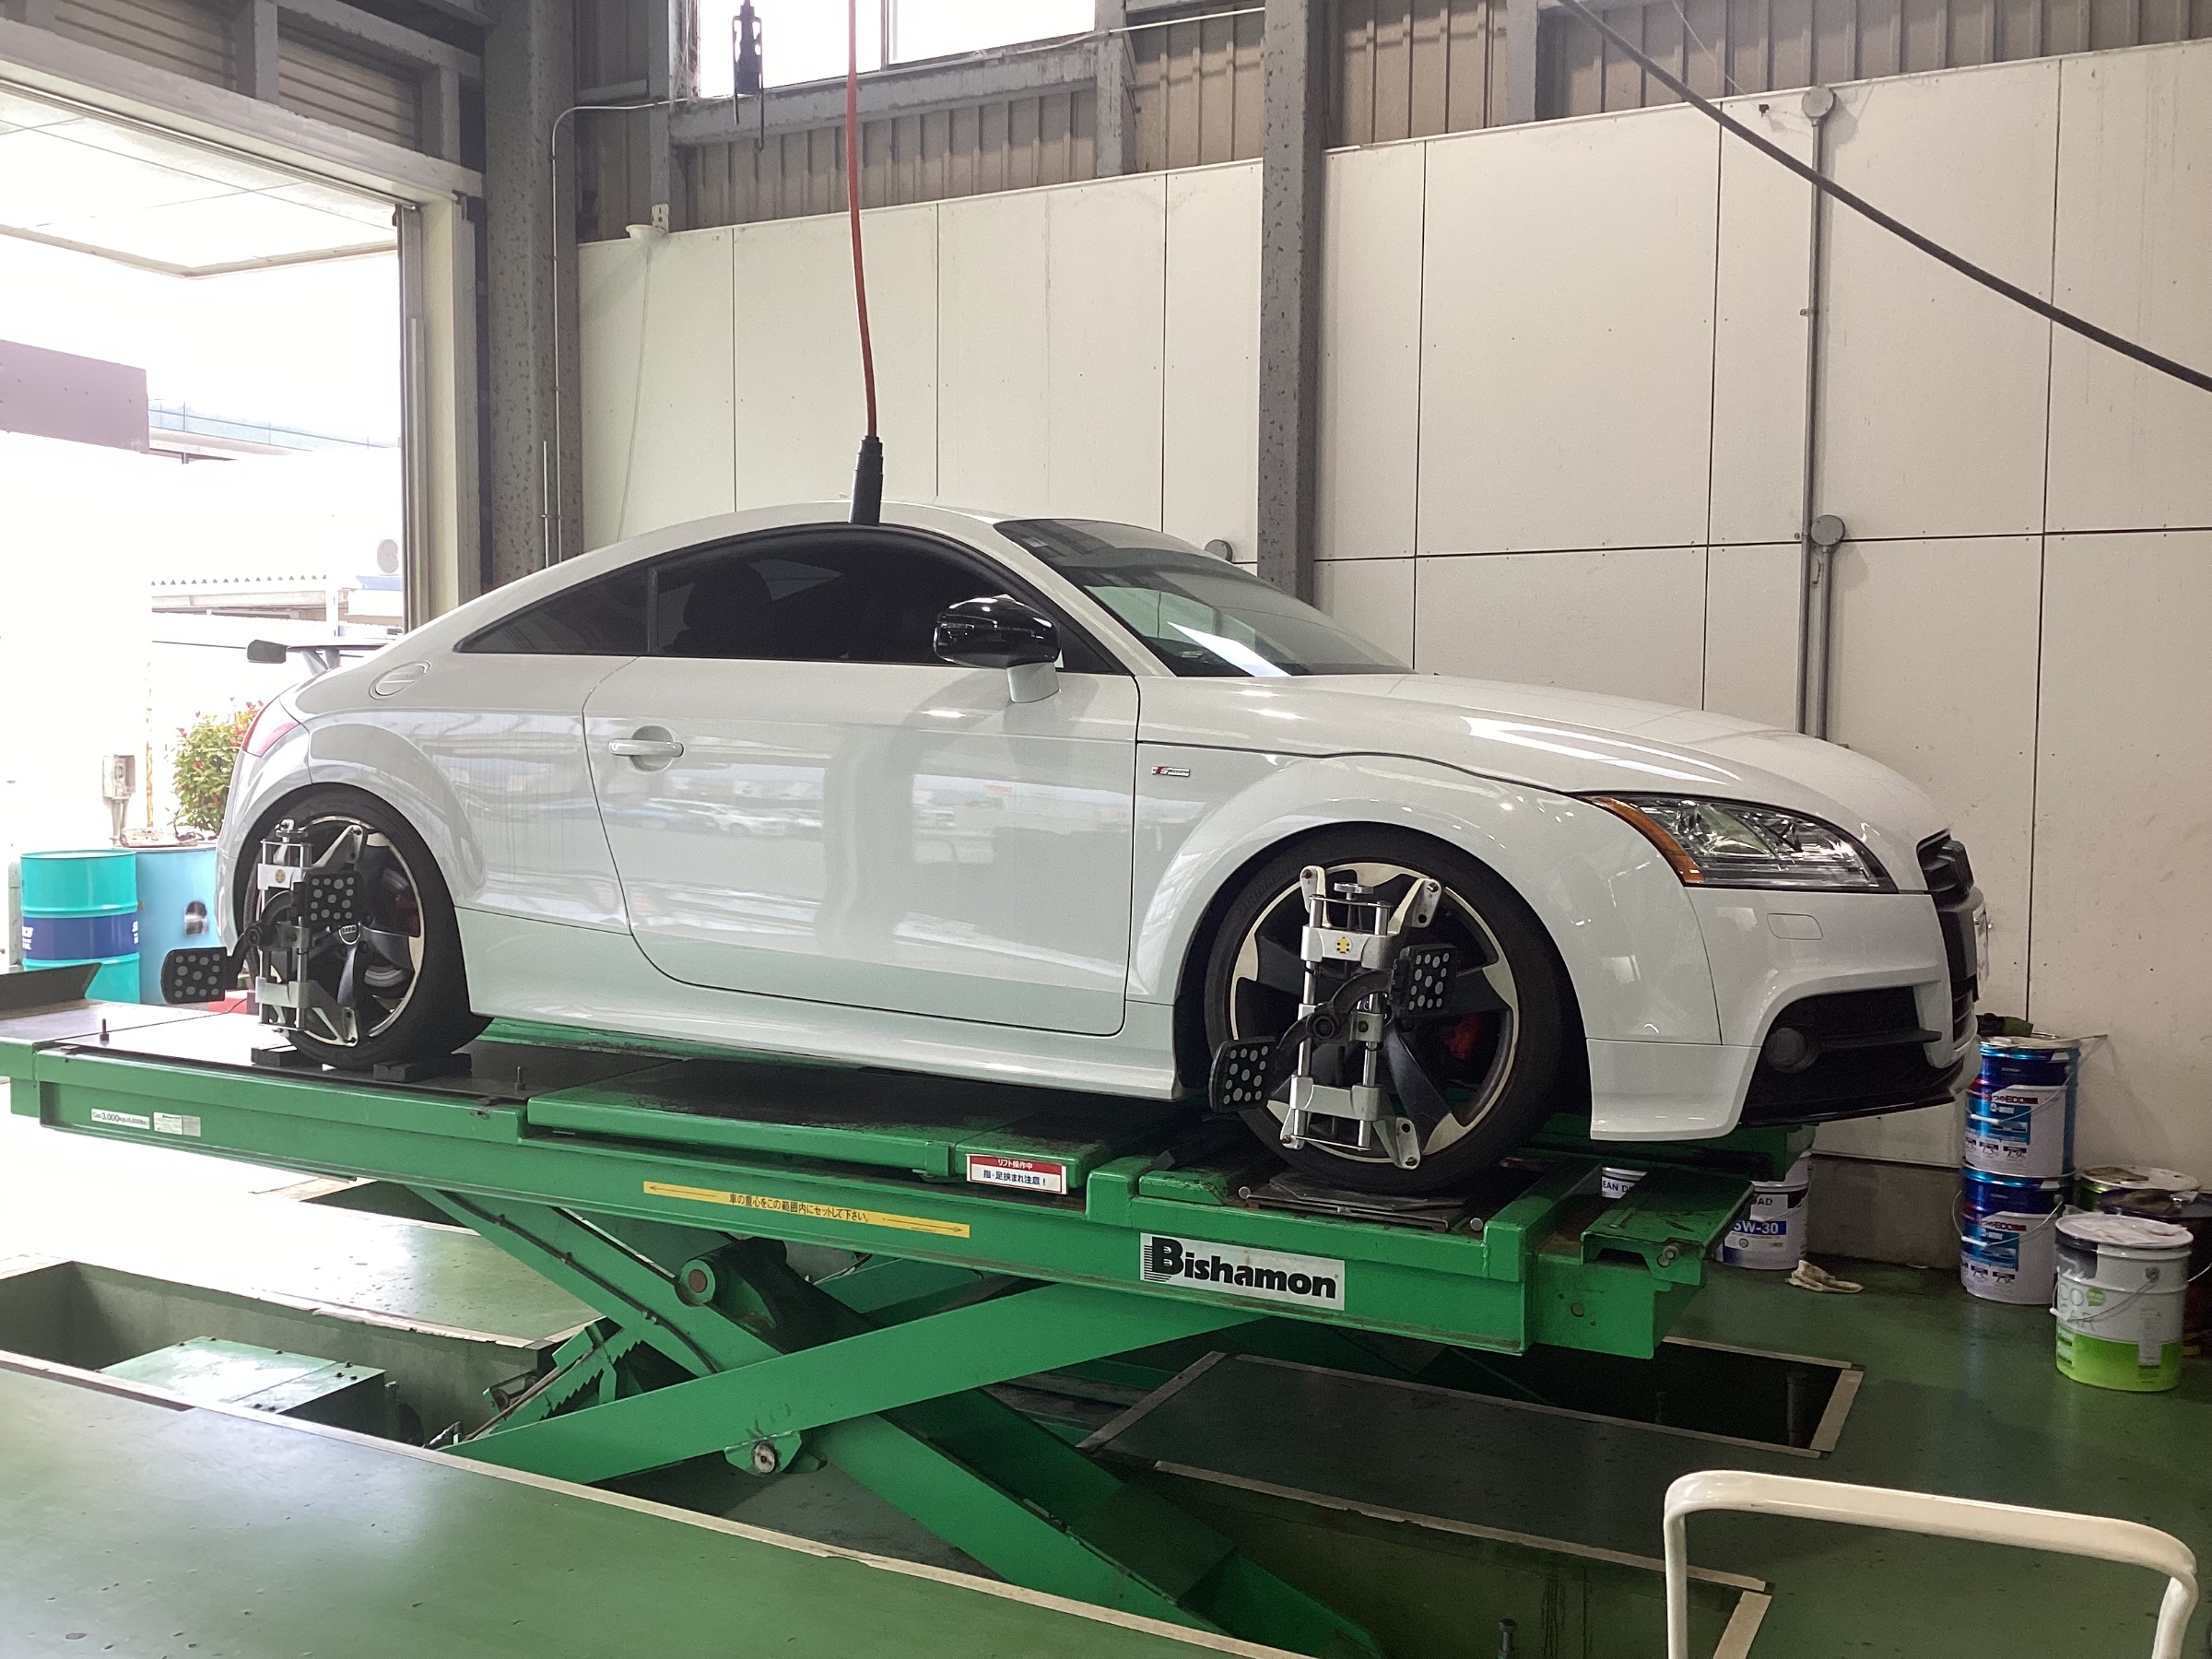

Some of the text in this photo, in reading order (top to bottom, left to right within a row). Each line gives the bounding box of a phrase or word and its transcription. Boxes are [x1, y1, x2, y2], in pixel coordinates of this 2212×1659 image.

[997, 1159, 1033, 1170] リフト操作中
[729, 1194, 869, 1222] 車の重心をこの範囲内にセットして下さい。
[1144, 1236, 1336, 1300] Bishamon
